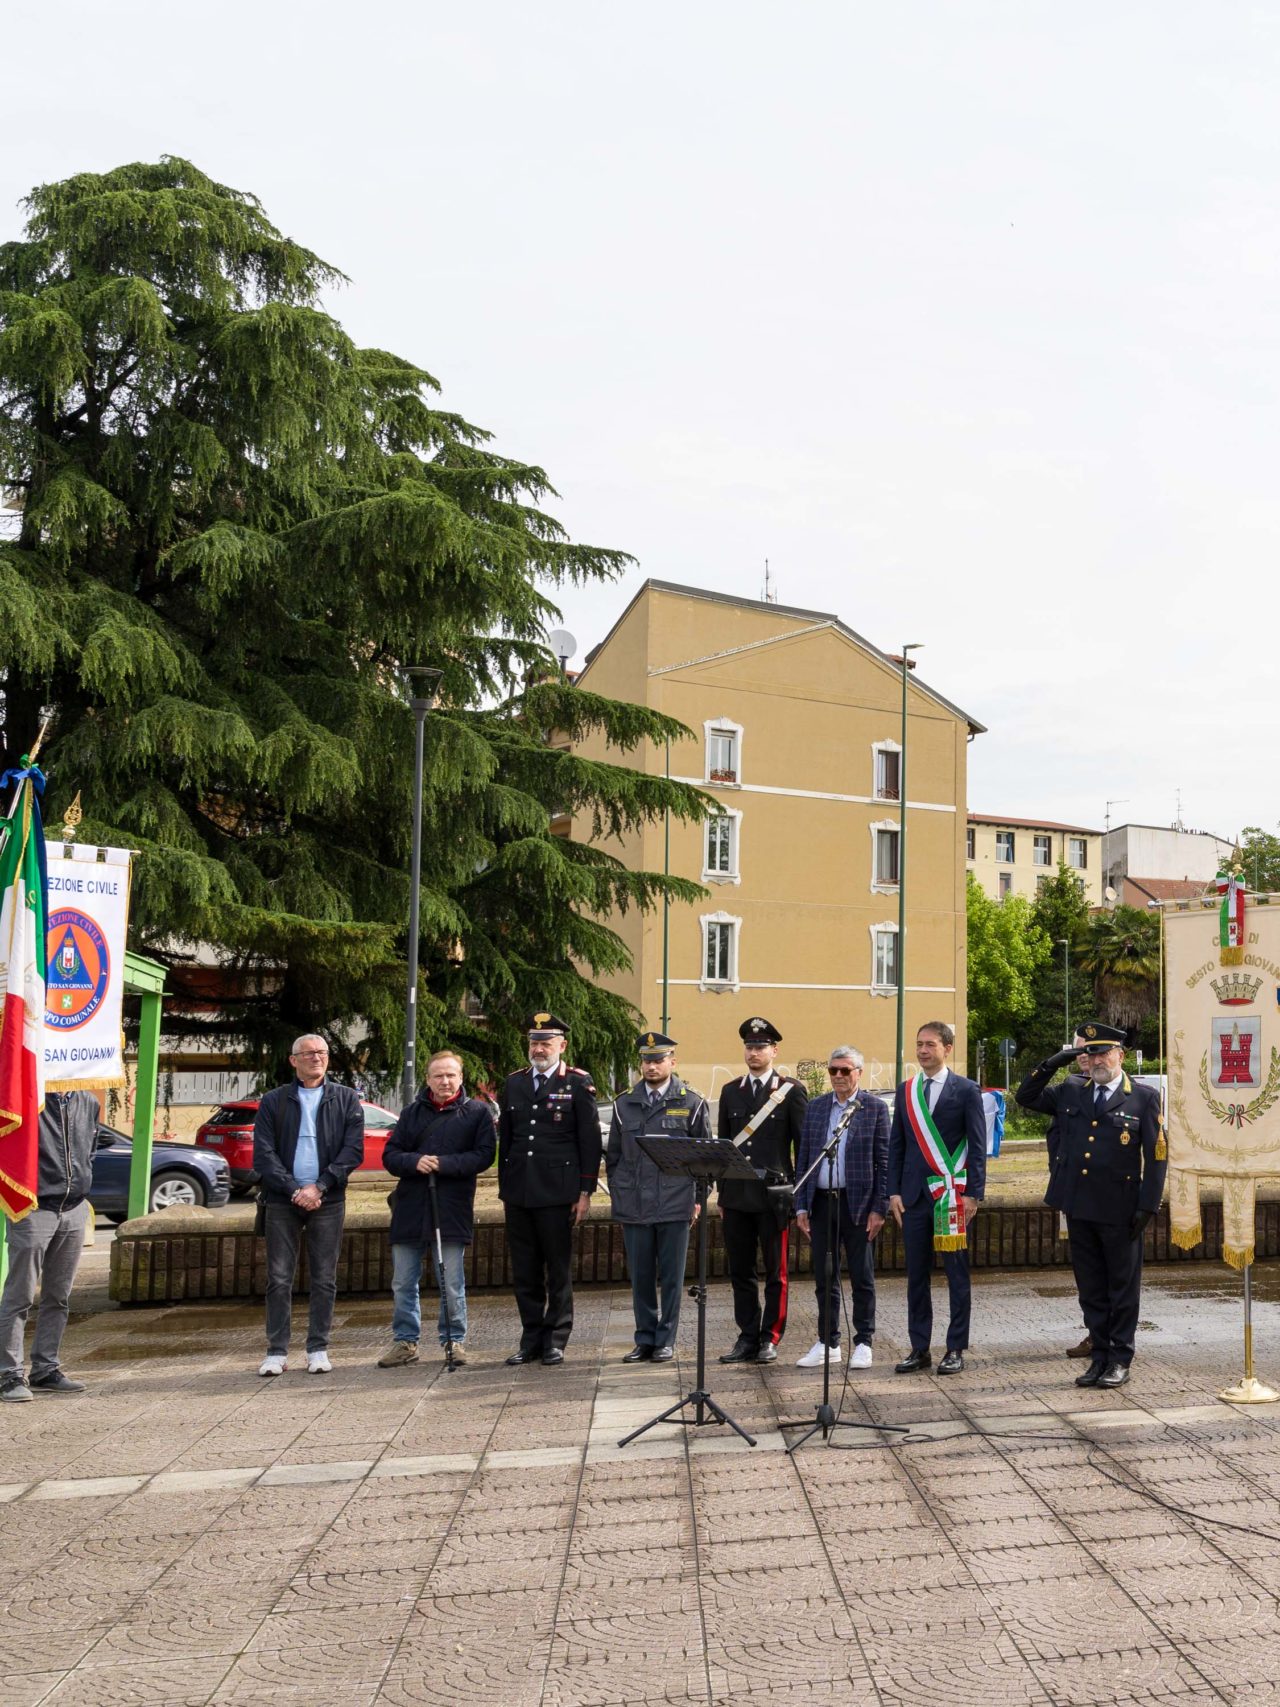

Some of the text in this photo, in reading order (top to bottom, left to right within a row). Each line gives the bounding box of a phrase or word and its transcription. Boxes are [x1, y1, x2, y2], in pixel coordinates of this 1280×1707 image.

[48, 876, 118, 895] EZIONE CIVILE
[48, 913, 79, 930] TEZIONE
[1248, 931, 1260, 944] DI
[1185, 961, 1215, 989] SESTO
[60, 995, 101, 1026] COMUNALE
[44, 1046, 116, 1062] SAN GIOVANNI
